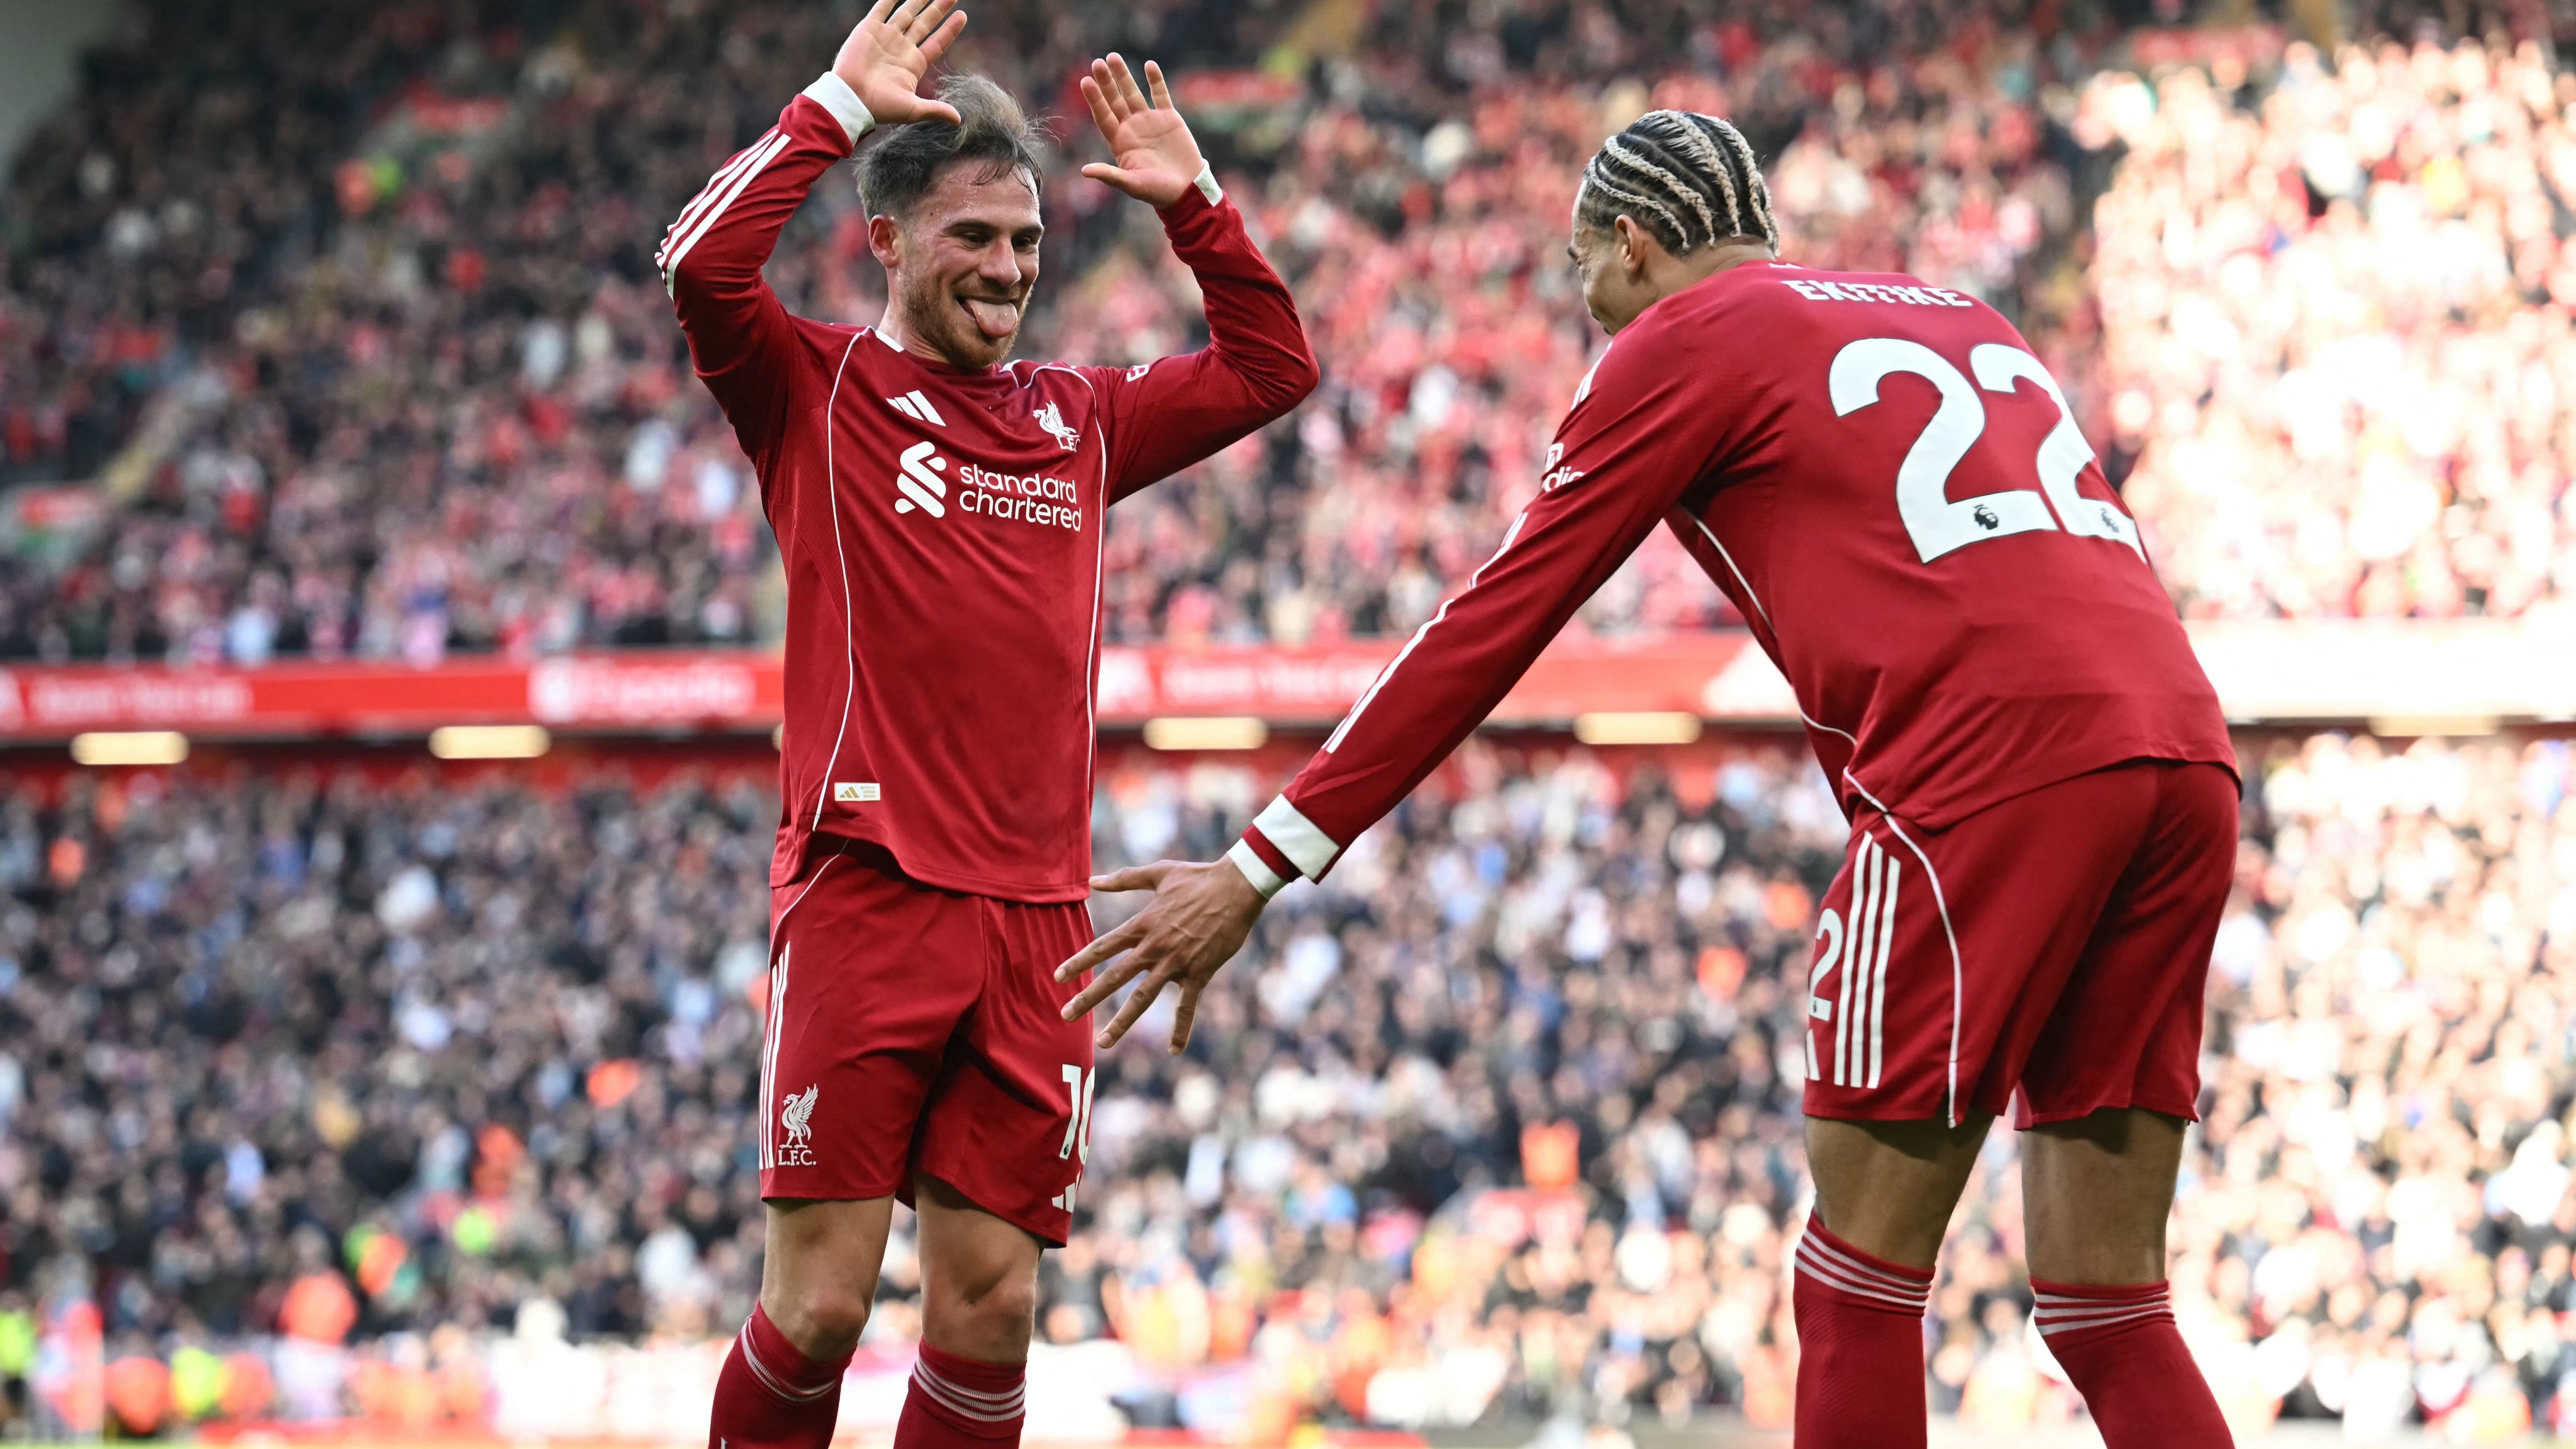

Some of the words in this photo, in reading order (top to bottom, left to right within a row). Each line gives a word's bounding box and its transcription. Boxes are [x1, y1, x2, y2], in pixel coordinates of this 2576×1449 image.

[1829, 338, 2149, 565] 22
[959, 463, 1077, 504] standard
[959, 487, 1082, 532] chartered
[778, 1149, 817, 1166] L.F.C.
